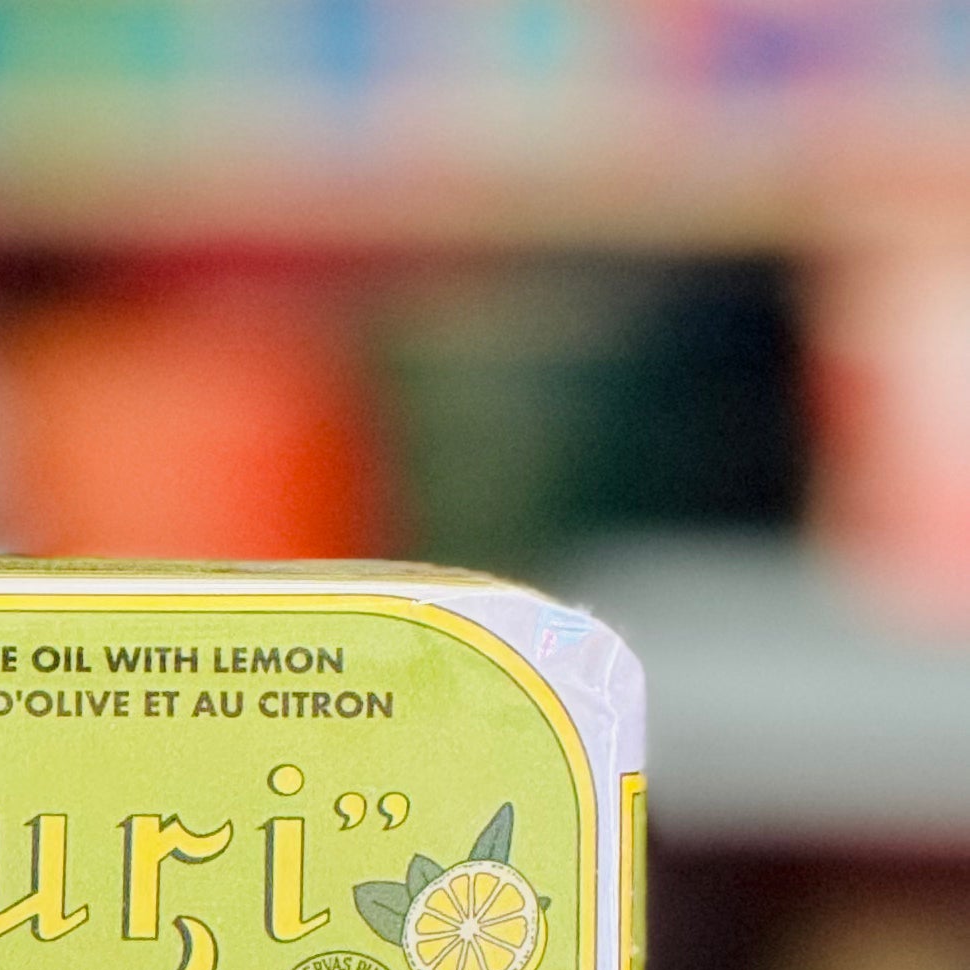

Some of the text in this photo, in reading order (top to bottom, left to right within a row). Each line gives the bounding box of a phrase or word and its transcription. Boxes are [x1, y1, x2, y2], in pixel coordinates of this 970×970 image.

[31, 645, 92, 674] OIL
[104, 646, 198, 674] WITH
[214, 646, 344, 675] LEMON
[144, 691, 180, 718] ET
[191, 691, 243, 719] AU
[258, 691, 394, 719] CITRON
